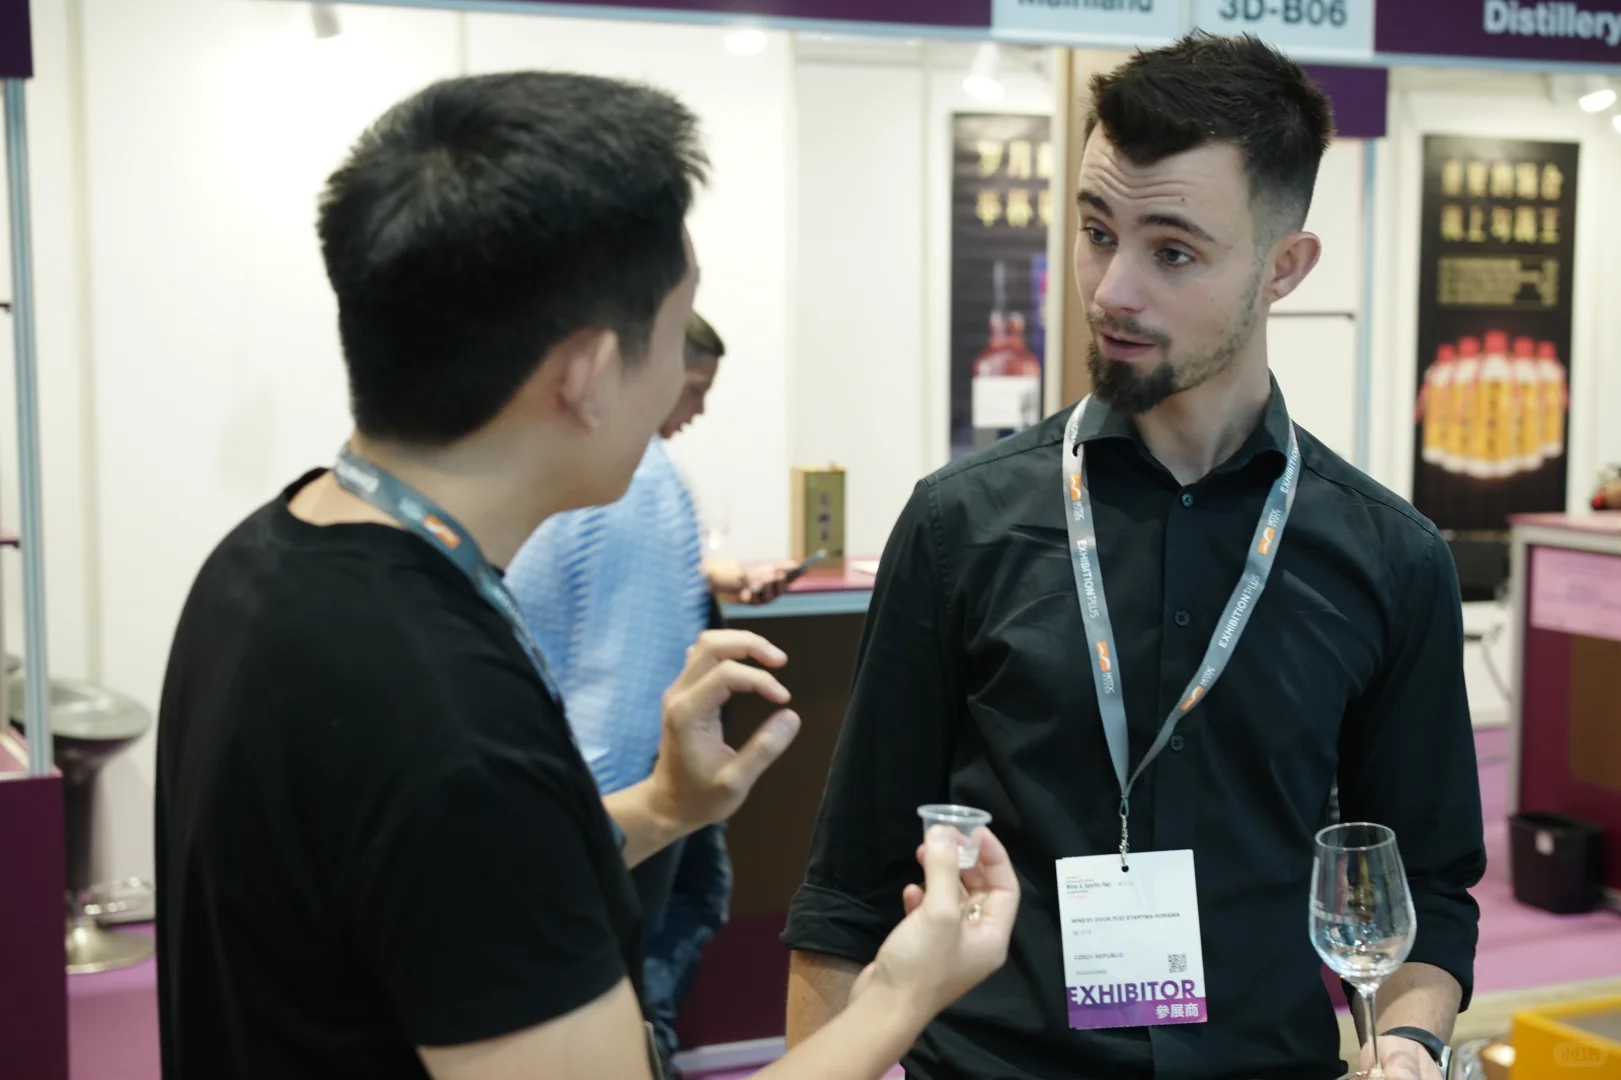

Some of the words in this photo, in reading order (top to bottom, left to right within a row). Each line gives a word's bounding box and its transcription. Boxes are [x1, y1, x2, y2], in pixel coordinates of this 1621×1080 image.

[1219, 0, 1347, 27] 3D-B06
[1484, 0, 1621, 47] Distillery
[1067, 979, 1197, 1004] EXHIBITOR
